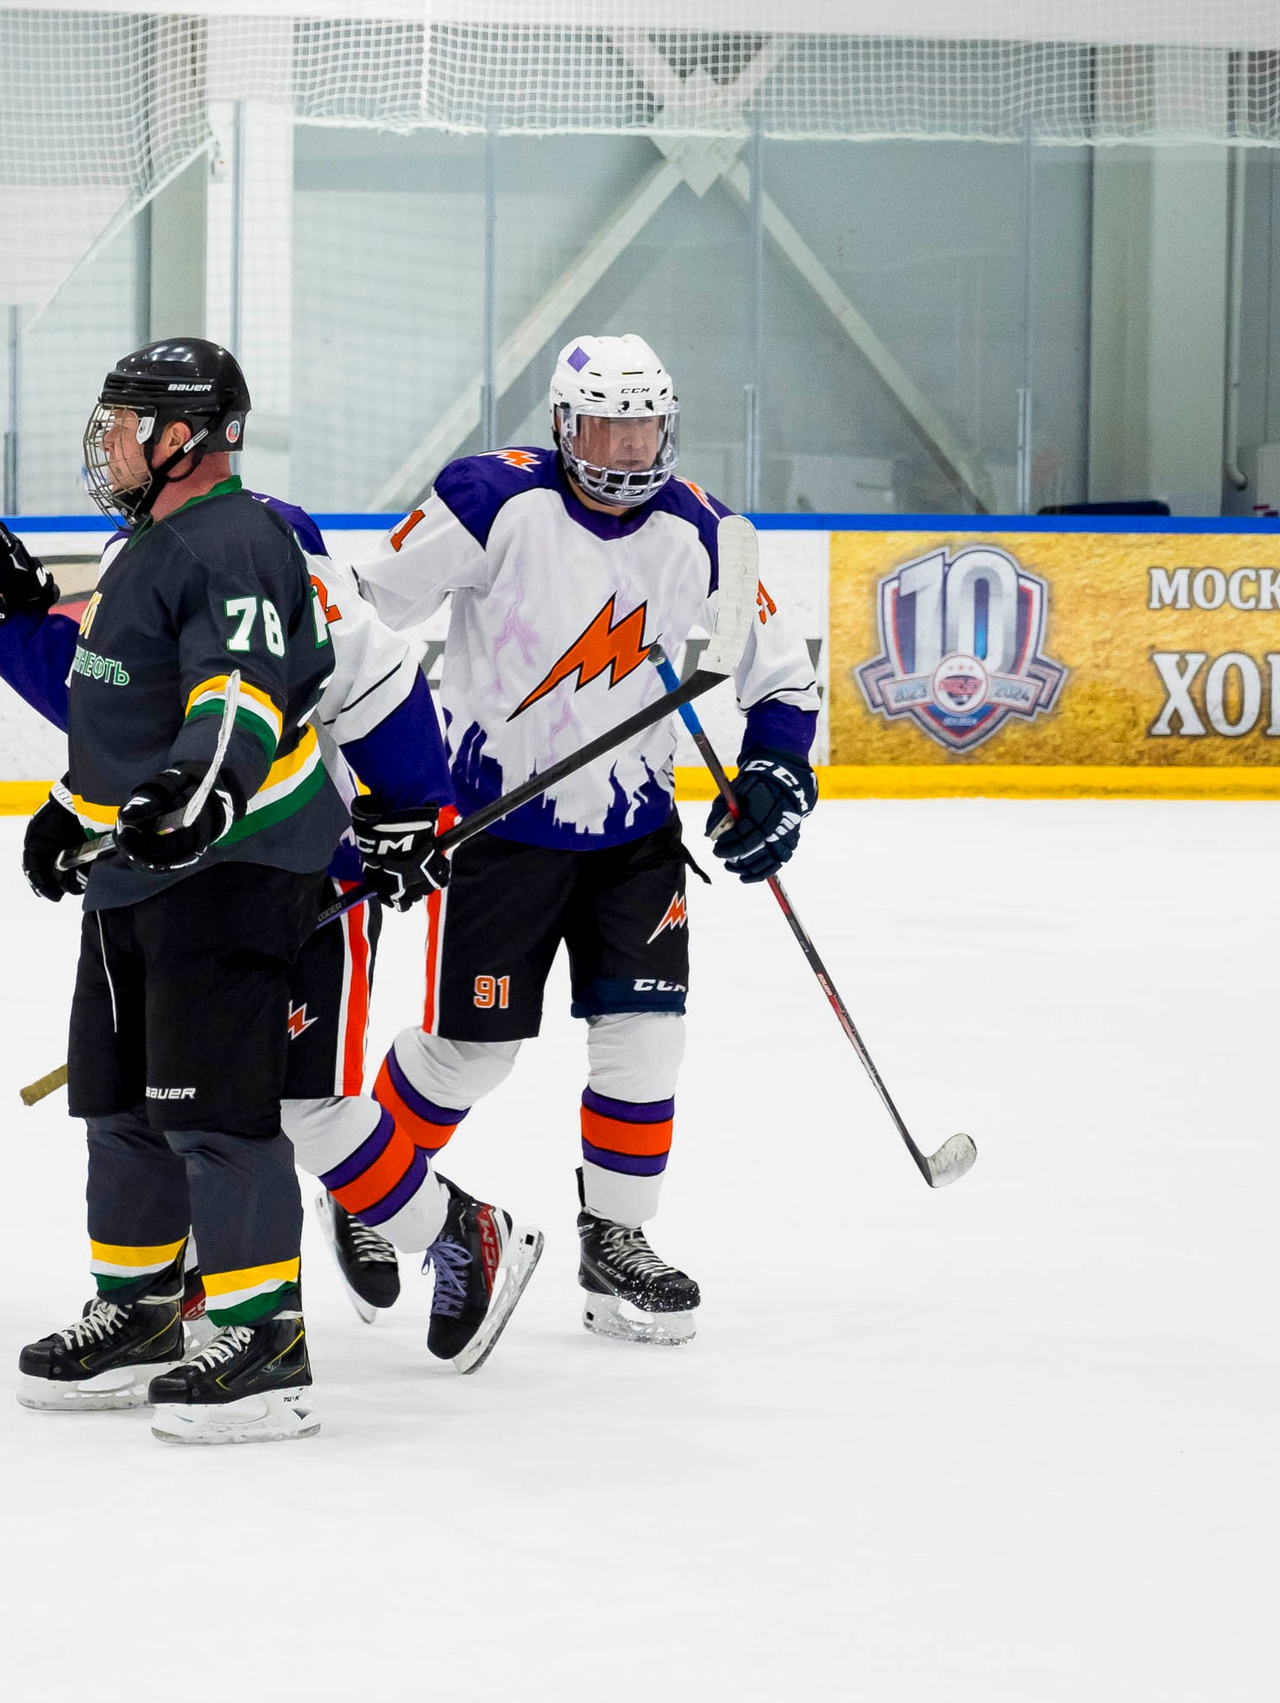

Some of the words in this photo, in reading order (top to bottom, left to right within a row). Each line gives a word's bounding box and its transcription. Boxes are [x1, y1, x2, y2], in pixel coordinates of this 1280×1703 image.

[167, 383, 212, 392] BAUER
[620, 387, 650, 395] CCM
[223, 595, 285, 659] 78
[898, 548, 1020, 674] 10
[73, 645, 130, 687] НЕФТЬ
[743, 759, 809, 812] CCM
[473, 974, 511, 1010] 91
